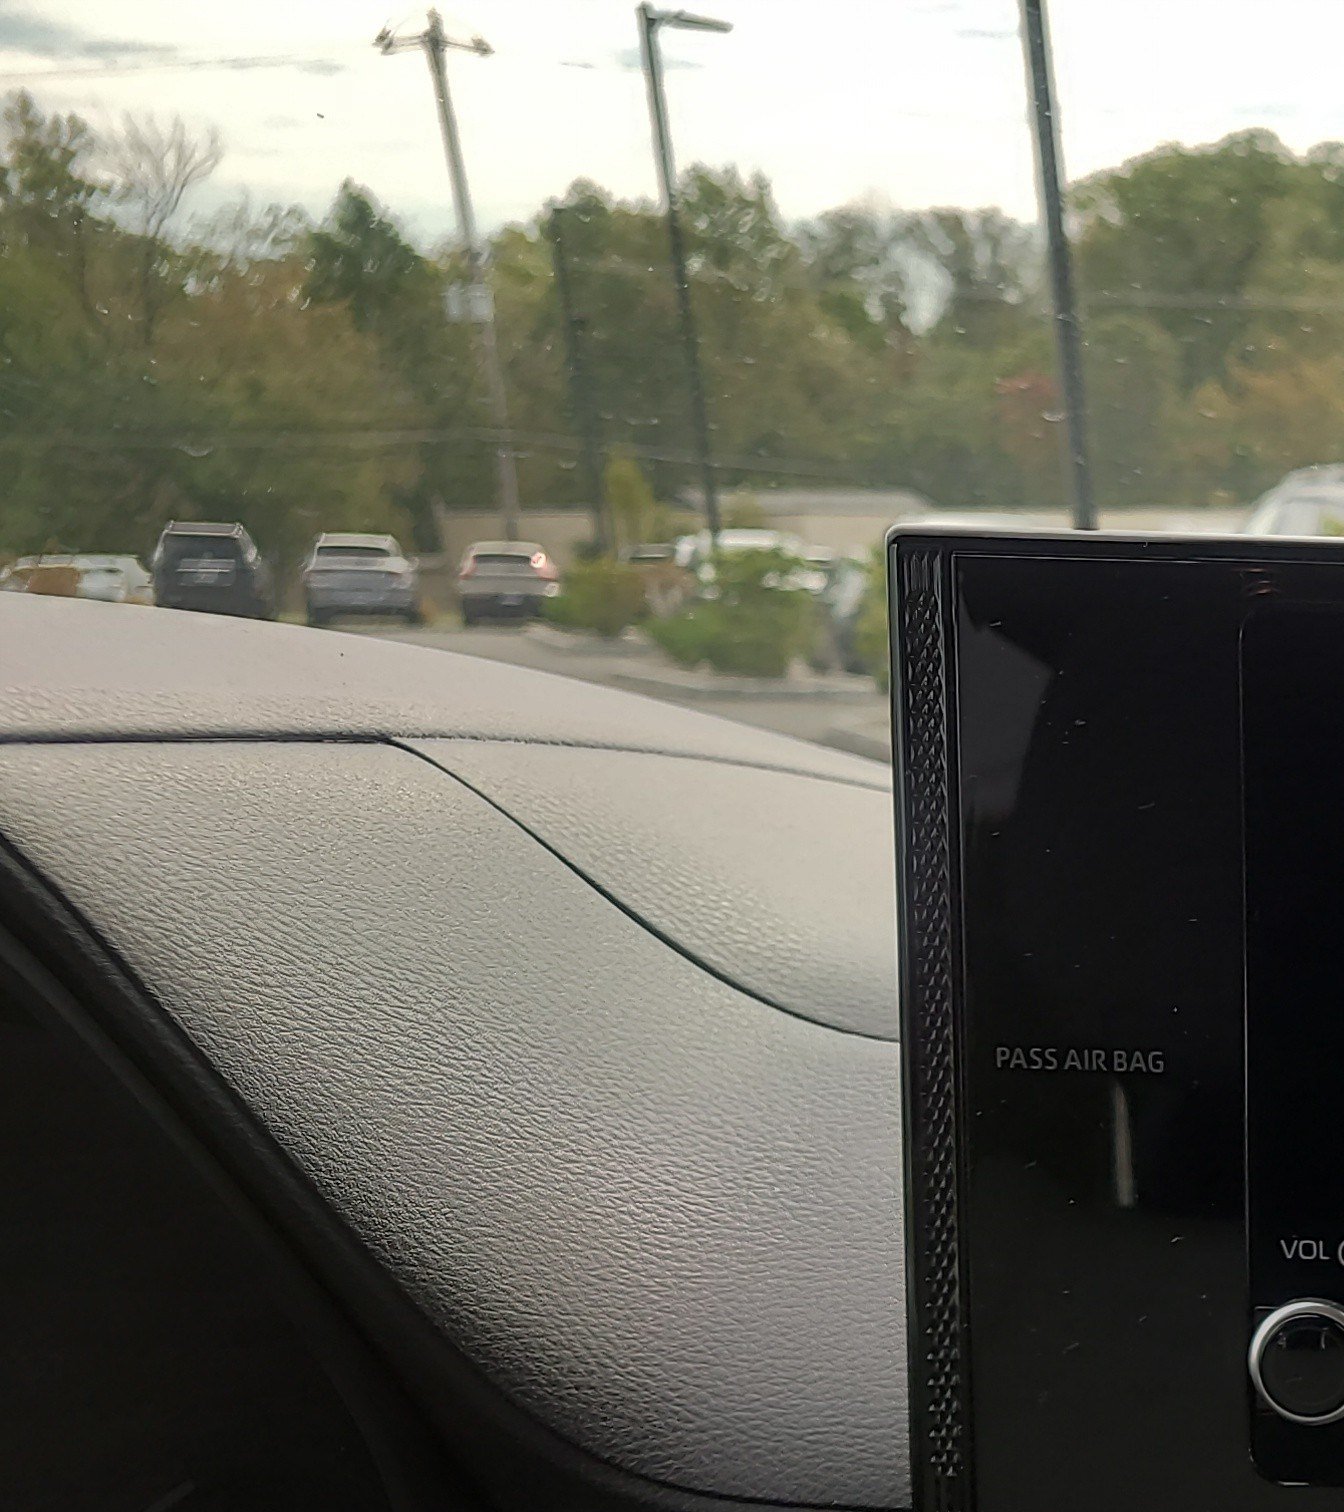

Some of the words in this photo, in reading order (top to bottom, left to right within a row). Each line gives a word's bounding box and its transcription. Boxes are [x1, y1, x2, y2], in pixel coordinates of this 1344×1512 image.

[996, 1047, 1059, 1071] PASS
[1063, 1048, 1108, 1072] AIR
[1112, 1050, 1166, 1074] BAG
[1279, 1239, 1330, 1261] VOL
